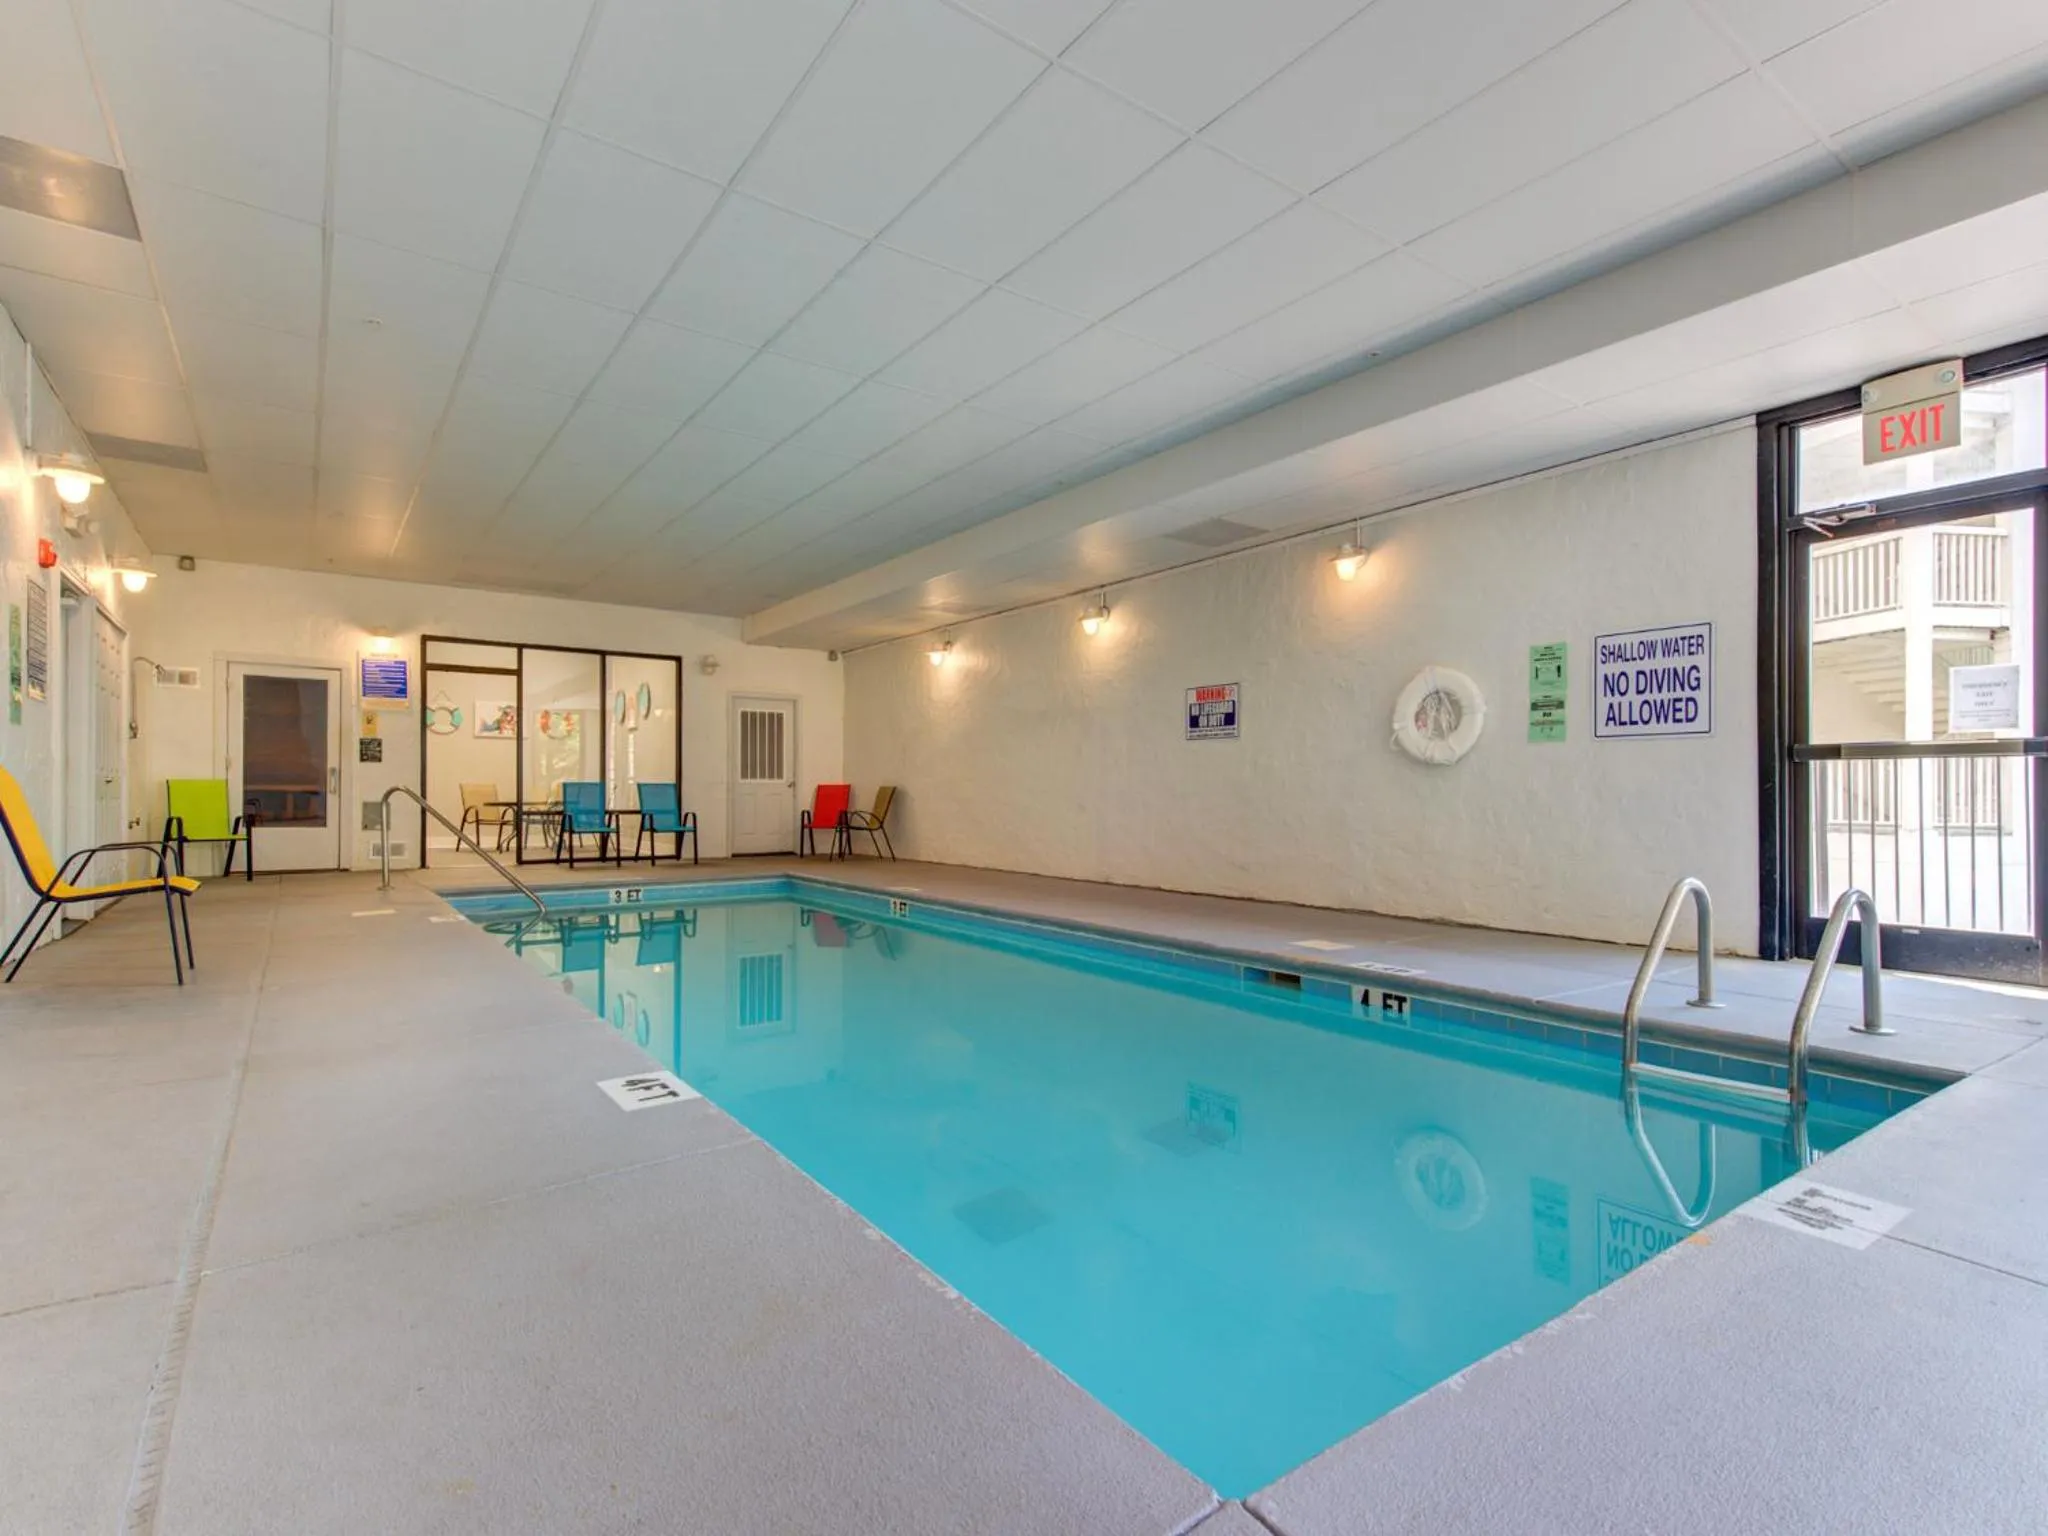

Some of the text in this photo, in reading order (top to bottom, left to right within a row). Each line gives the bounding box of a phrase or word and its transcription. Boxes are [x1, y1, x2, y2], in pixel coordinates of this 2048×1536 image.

[1880, 403, 1945, 453] EXIT
[1600, 634, 1705, 665] SHALLOW WATER
[1603, 664, 1701, 697] NO DIVING
[1605, 697, 1699, 727] ALLOWED
[1382, 991, 1408, 1014] FT
